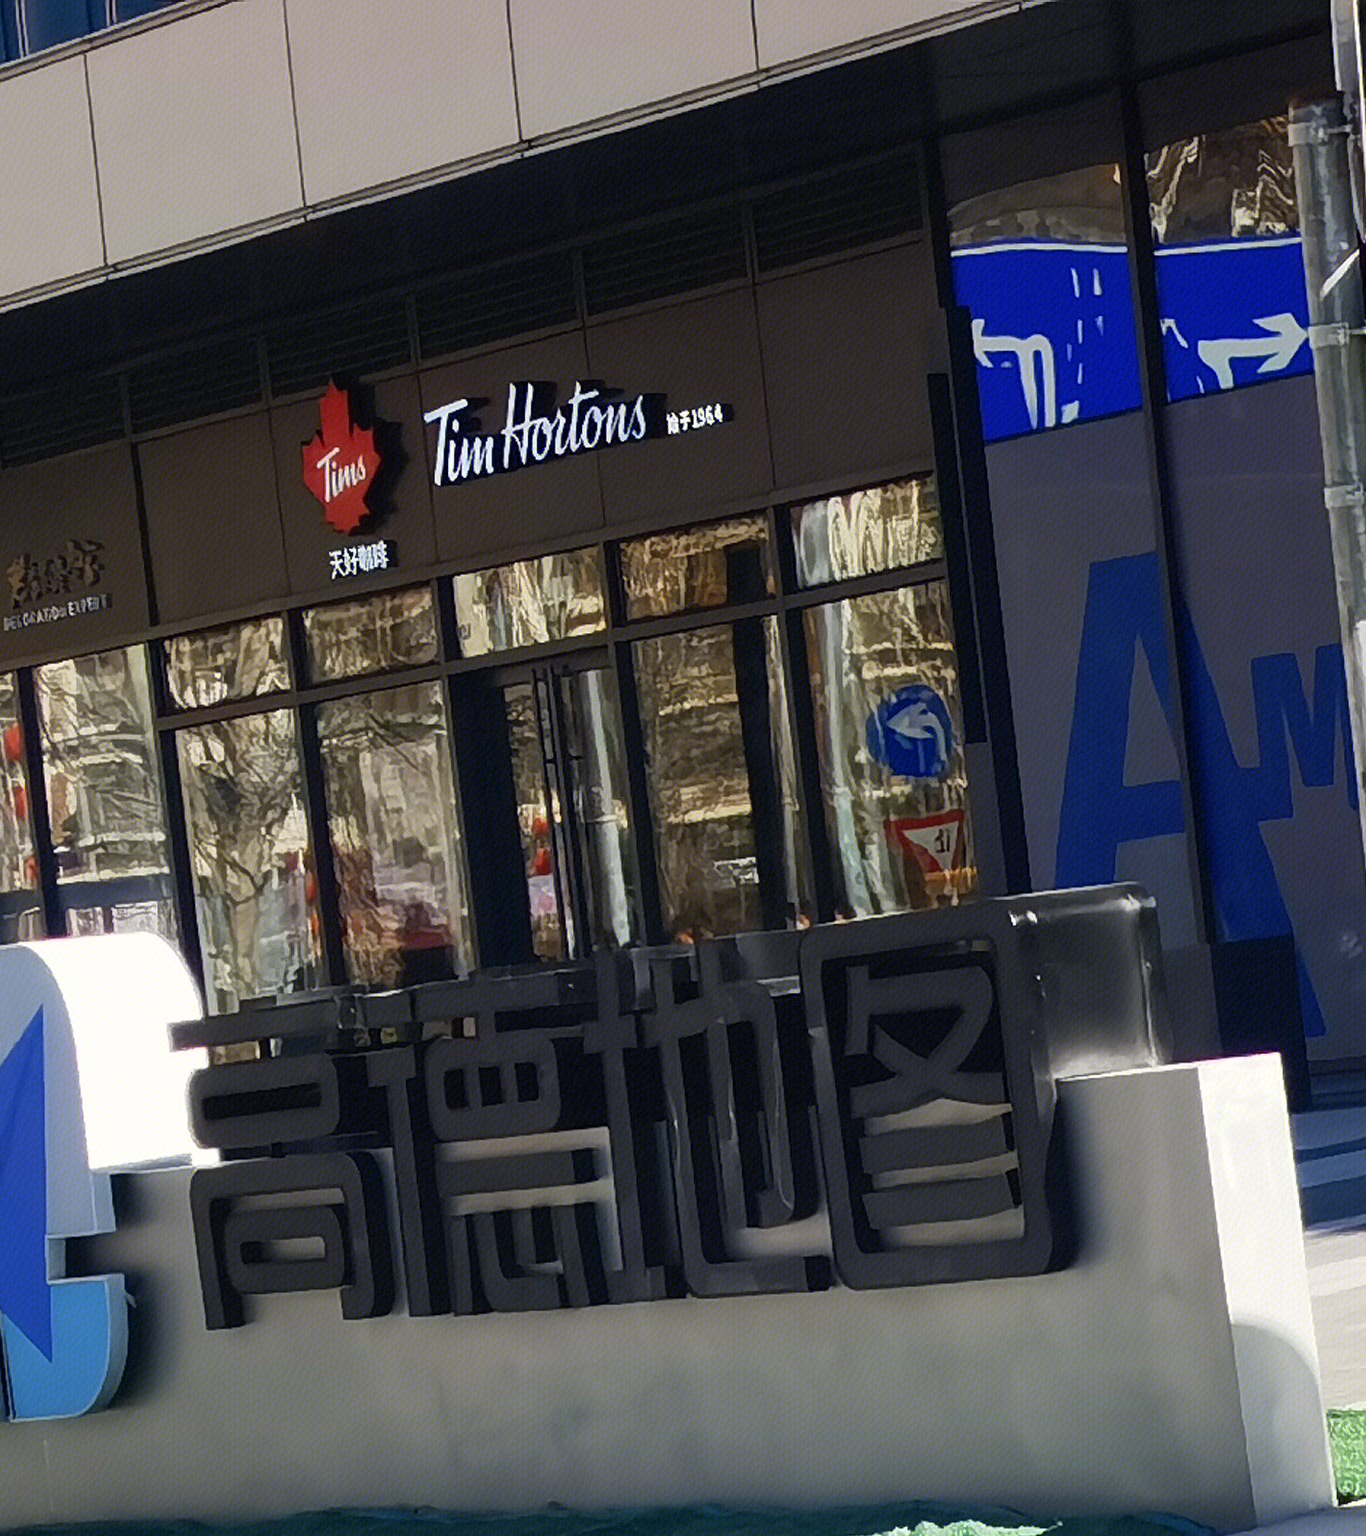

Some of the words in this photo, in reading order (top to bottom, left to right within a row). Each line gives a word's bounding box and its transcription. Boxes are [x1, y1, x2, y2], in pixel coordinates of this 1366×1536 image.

[424, 398, 494, 486] Tim
[501, 380, 647, 469] Hortons
[316, 446, 367, 503] Tims
[329, 540, 389, 580] 天好咖啡
[168, 925, 1065, 1330] 高德地图
